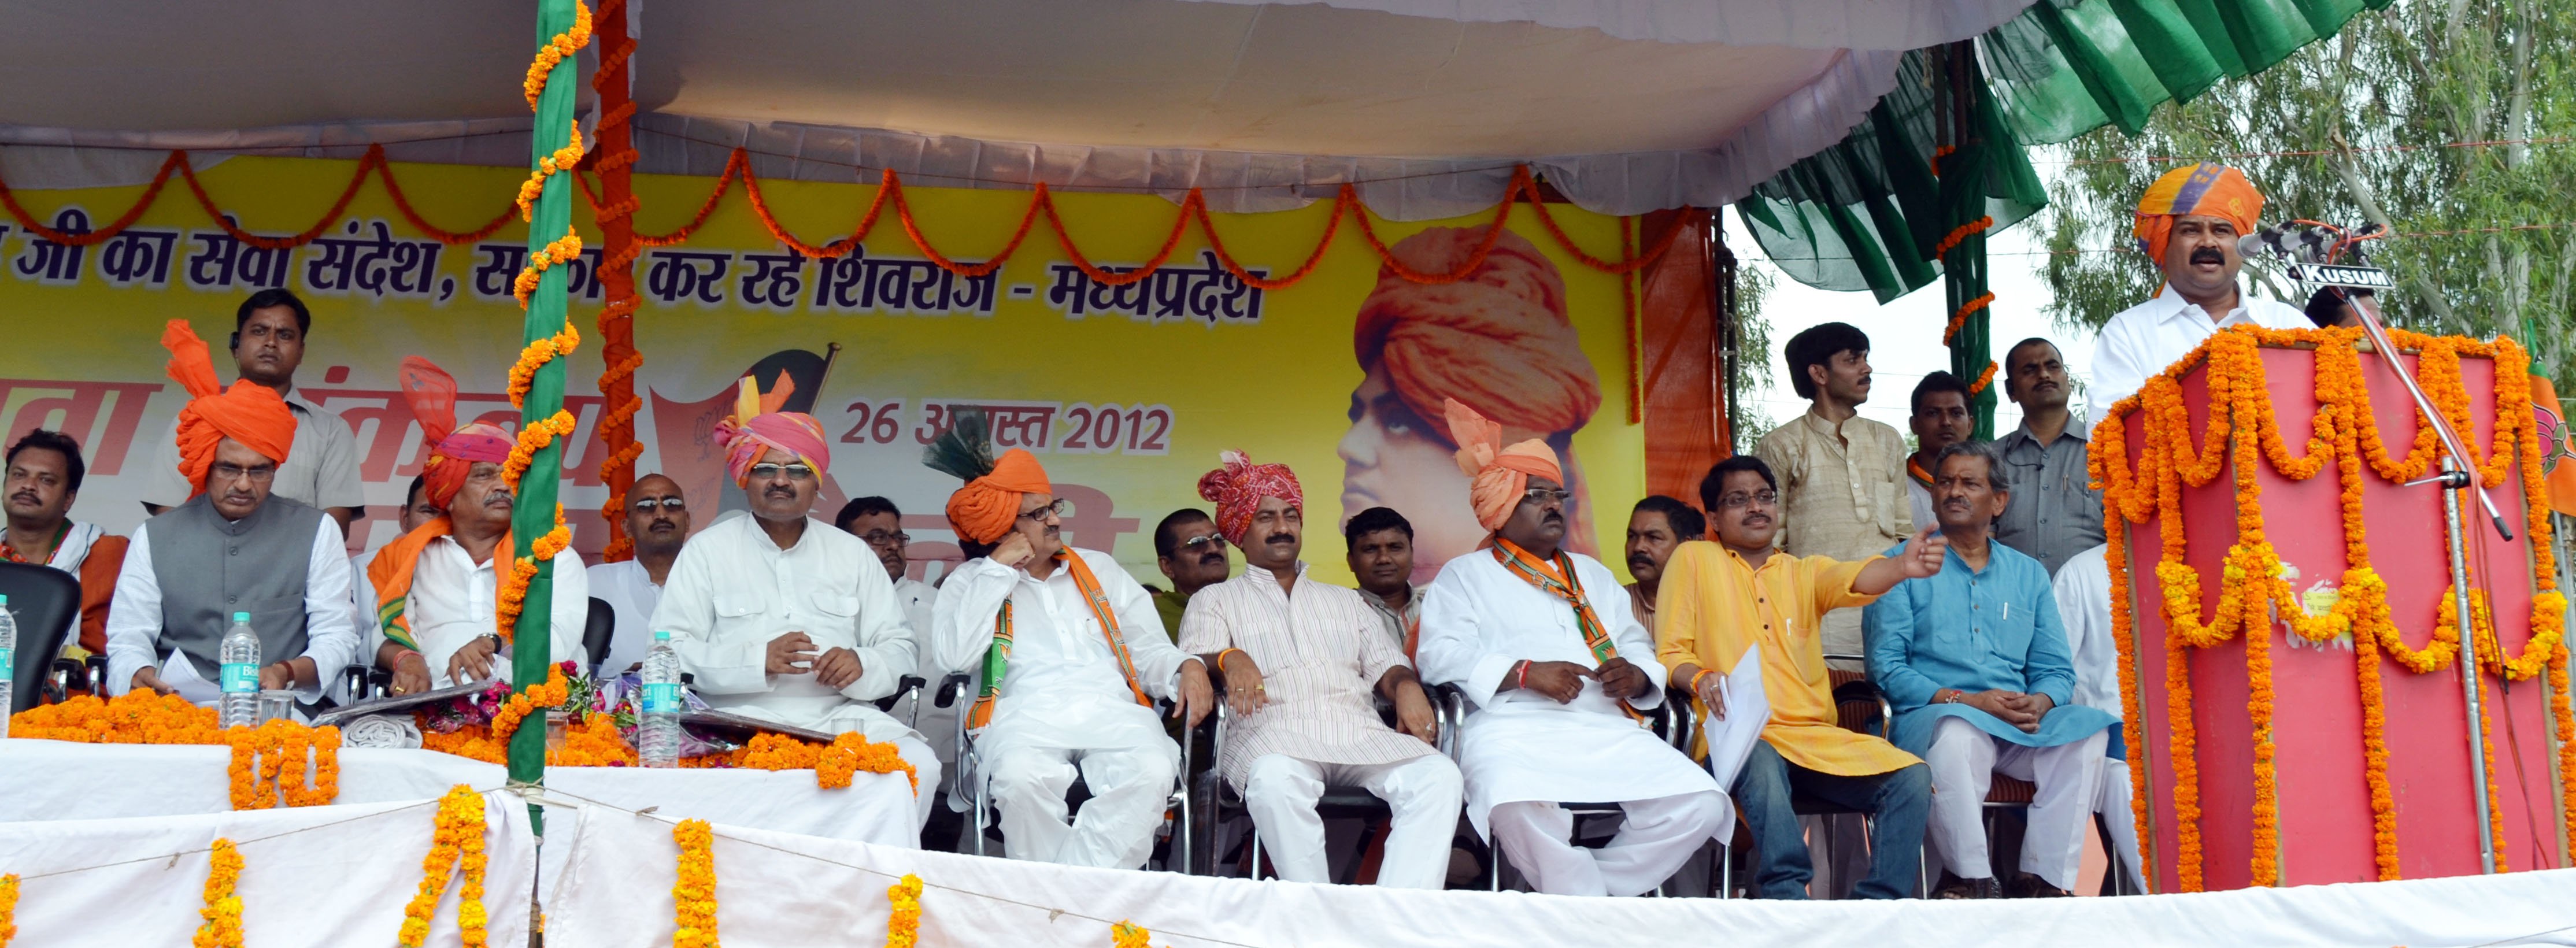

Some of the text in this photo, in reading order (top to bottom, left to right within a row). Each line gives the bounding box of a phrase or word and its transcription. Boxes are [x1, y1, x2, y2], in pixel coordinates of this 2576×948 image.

[17, 209, 91, 280] जी
[102, 229, 177, 283] का
[190, 216, 294, 287] सेवा
[308, 221, 454, 301] संदेश,
[649, 251, 732, 303] कर
[742, 244, 806, 307] रहे
[815, 239, 1000, 311] शिवराज
[1049, 251, 1267, 323] मध्यप्रदेश
[2301, 264, 2389, 286] KUSUM
[840, 402, 1169, 450] 26 अस्त 2012
